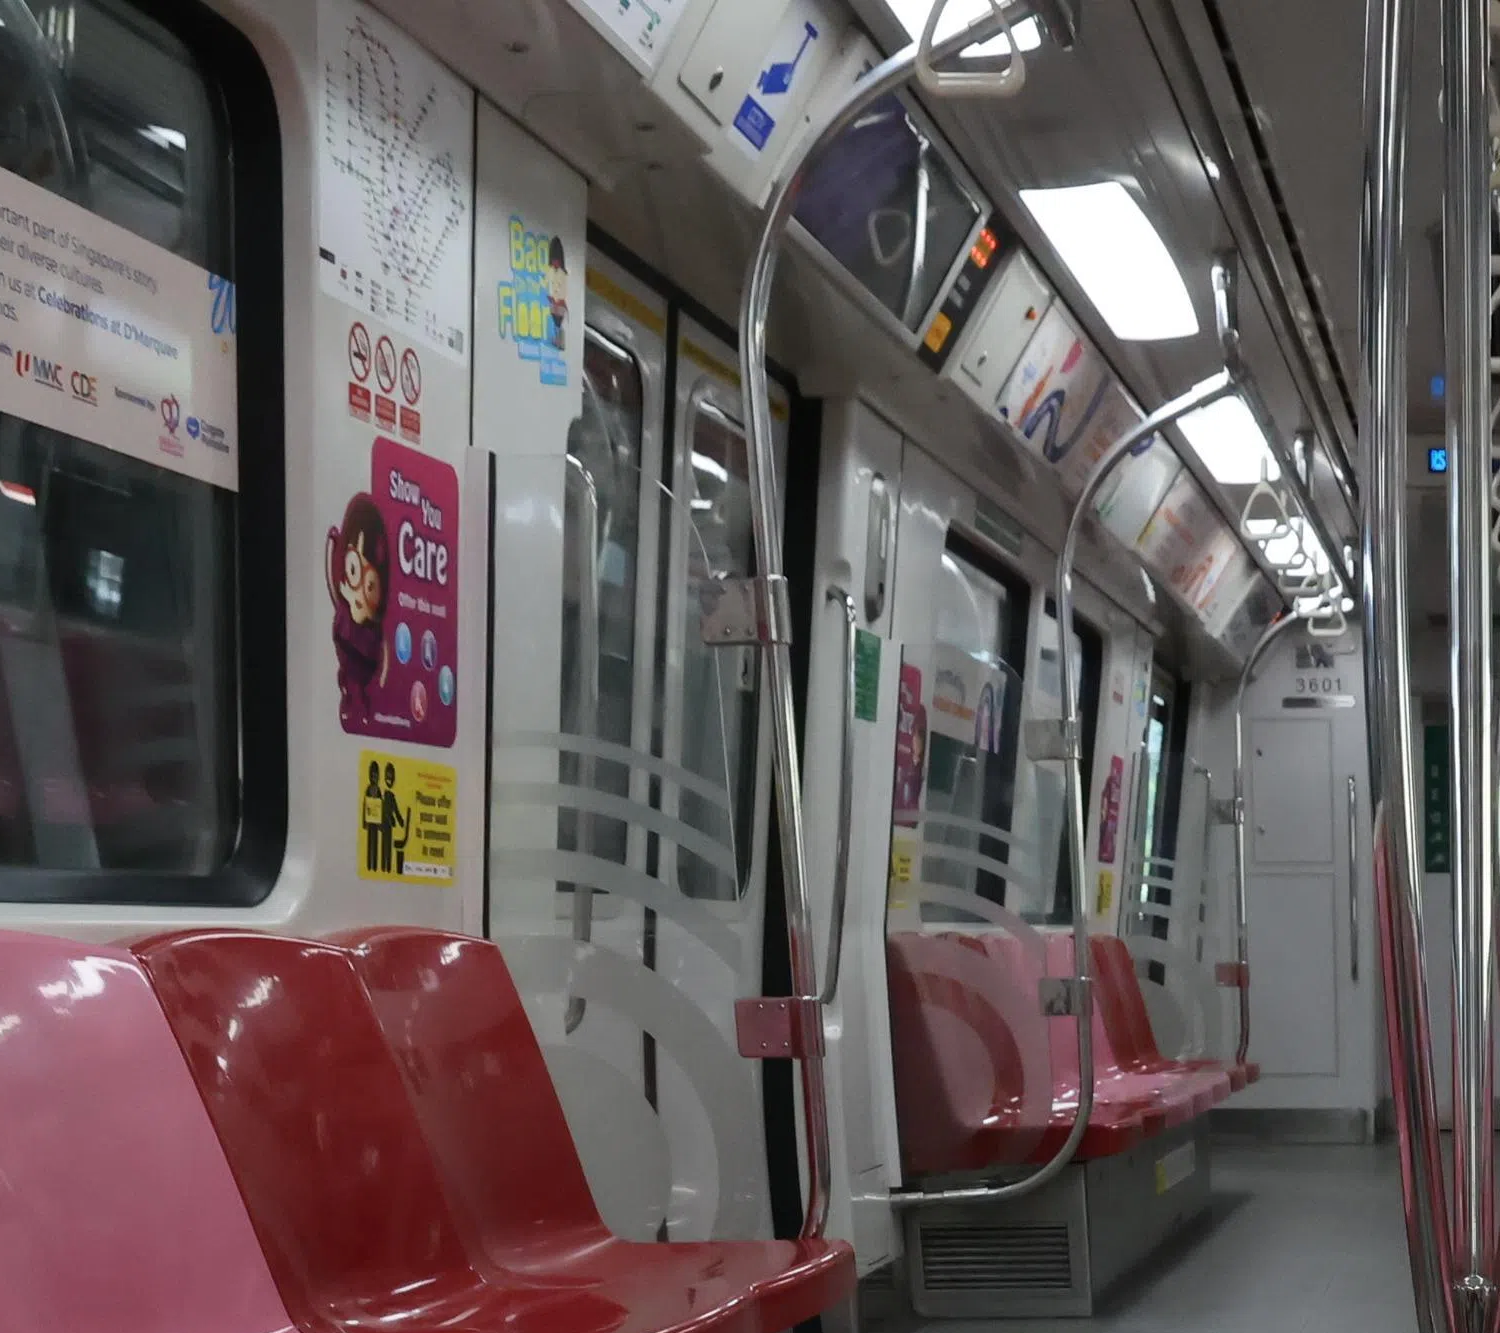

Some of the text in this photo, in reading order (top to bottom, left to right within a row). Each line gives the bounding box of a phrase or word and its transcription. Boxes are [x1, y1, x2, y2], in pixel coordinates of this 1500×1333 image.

[17, 242, 58, 273] diverse
[32, 219, 56, 244] part
[59, 231, 70, 249] of
[9, 278, 22, 296] us
[24, 281, 37, 301] at
[38, 287, 109, 331] Celebrations
[124, 322, 179, 360] D'Marquee
[389, 469, 442, 530] Show You
[398, 521, 448, 585] Care
